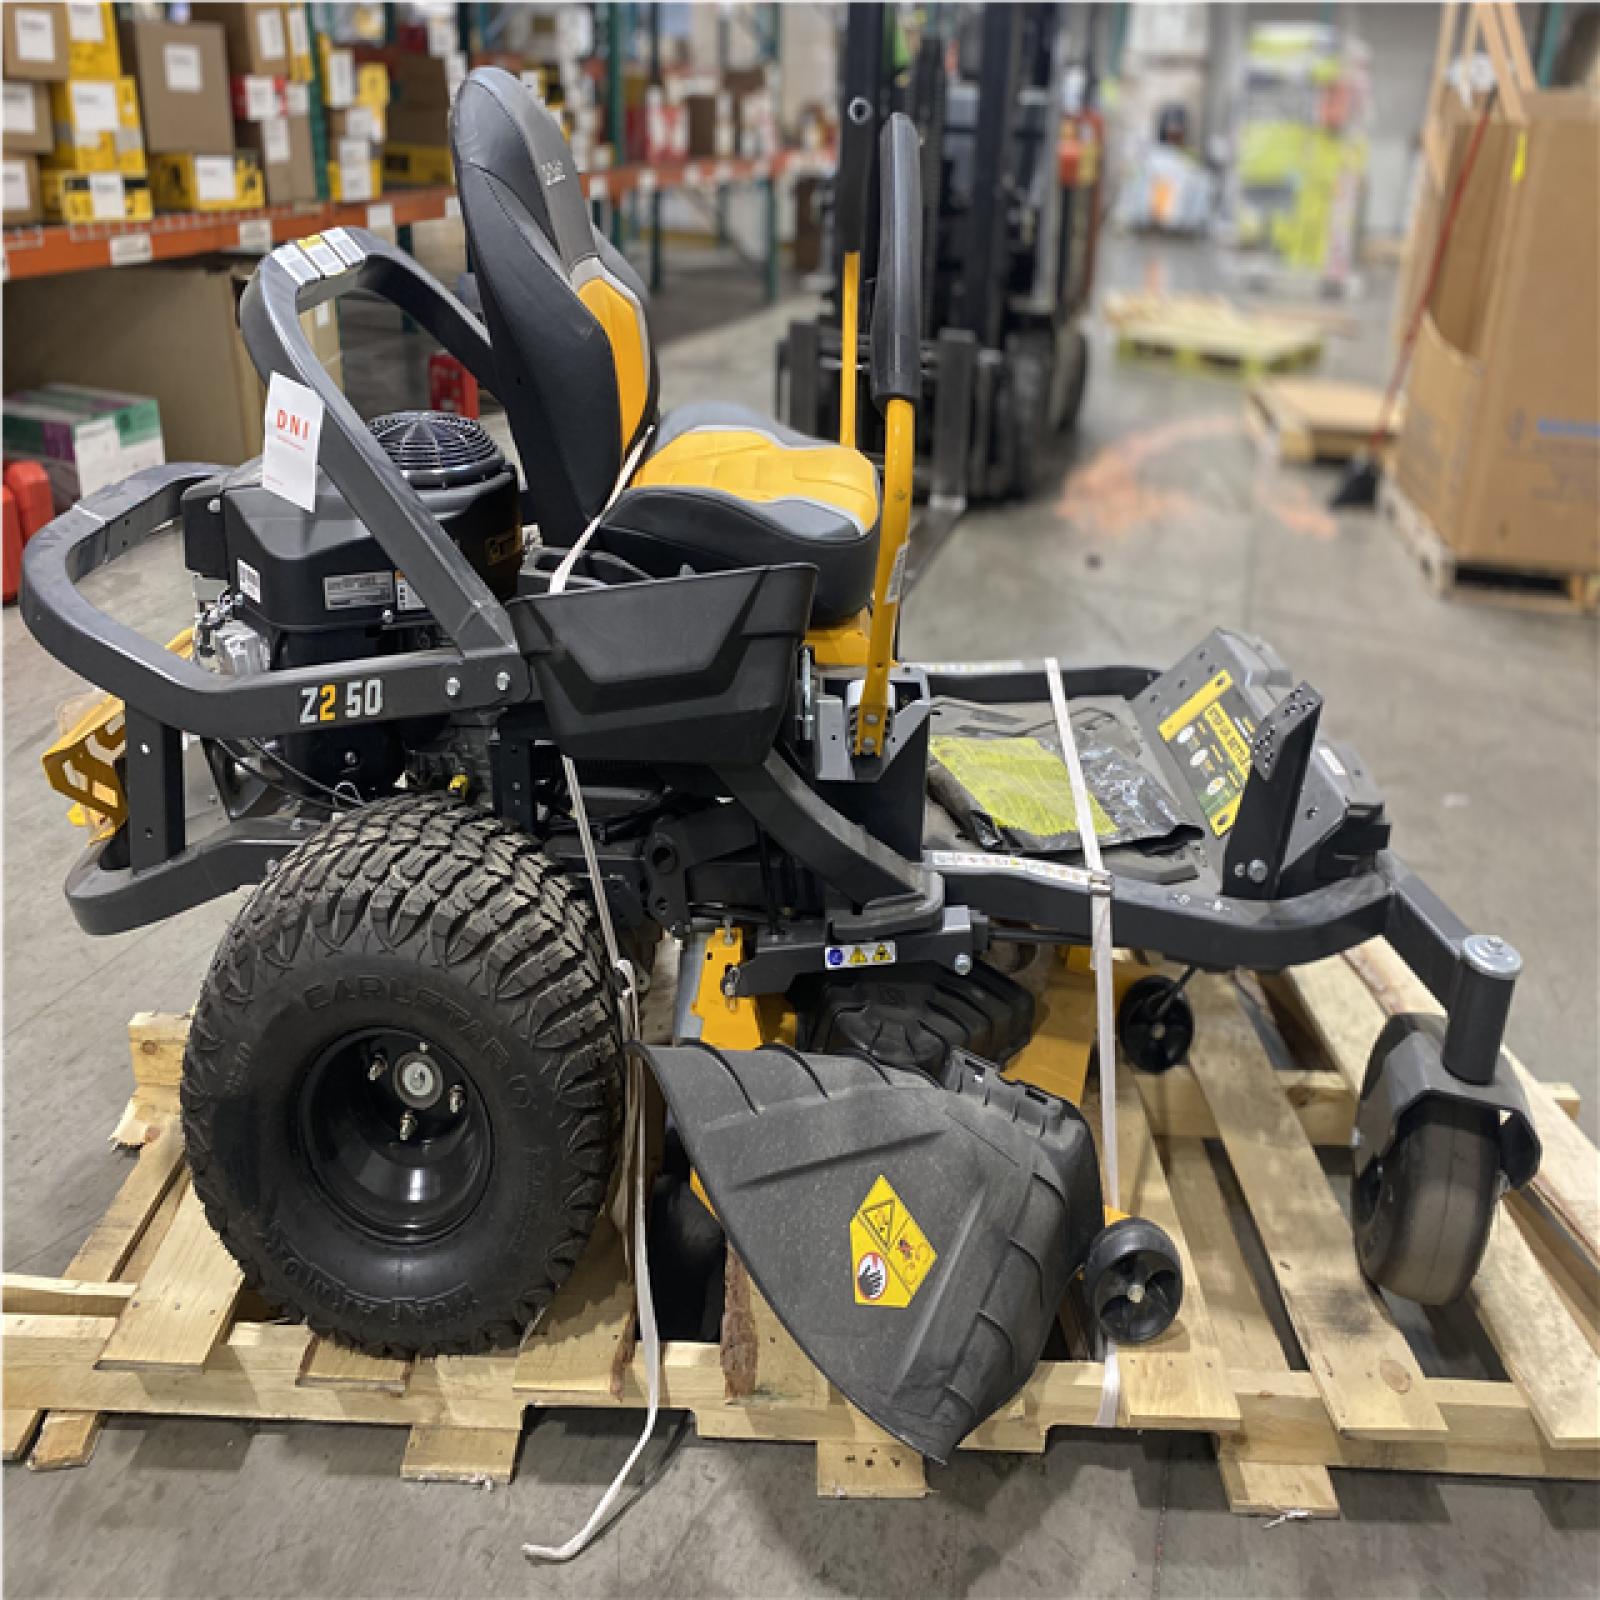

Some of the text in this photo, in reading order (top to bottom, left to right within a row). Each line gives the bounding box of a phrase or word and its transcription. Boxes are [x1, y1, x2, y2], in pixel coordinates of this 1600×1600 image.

[277, 408, 310, 440] DNI
[300, 679, 383, 723] Z2 50
